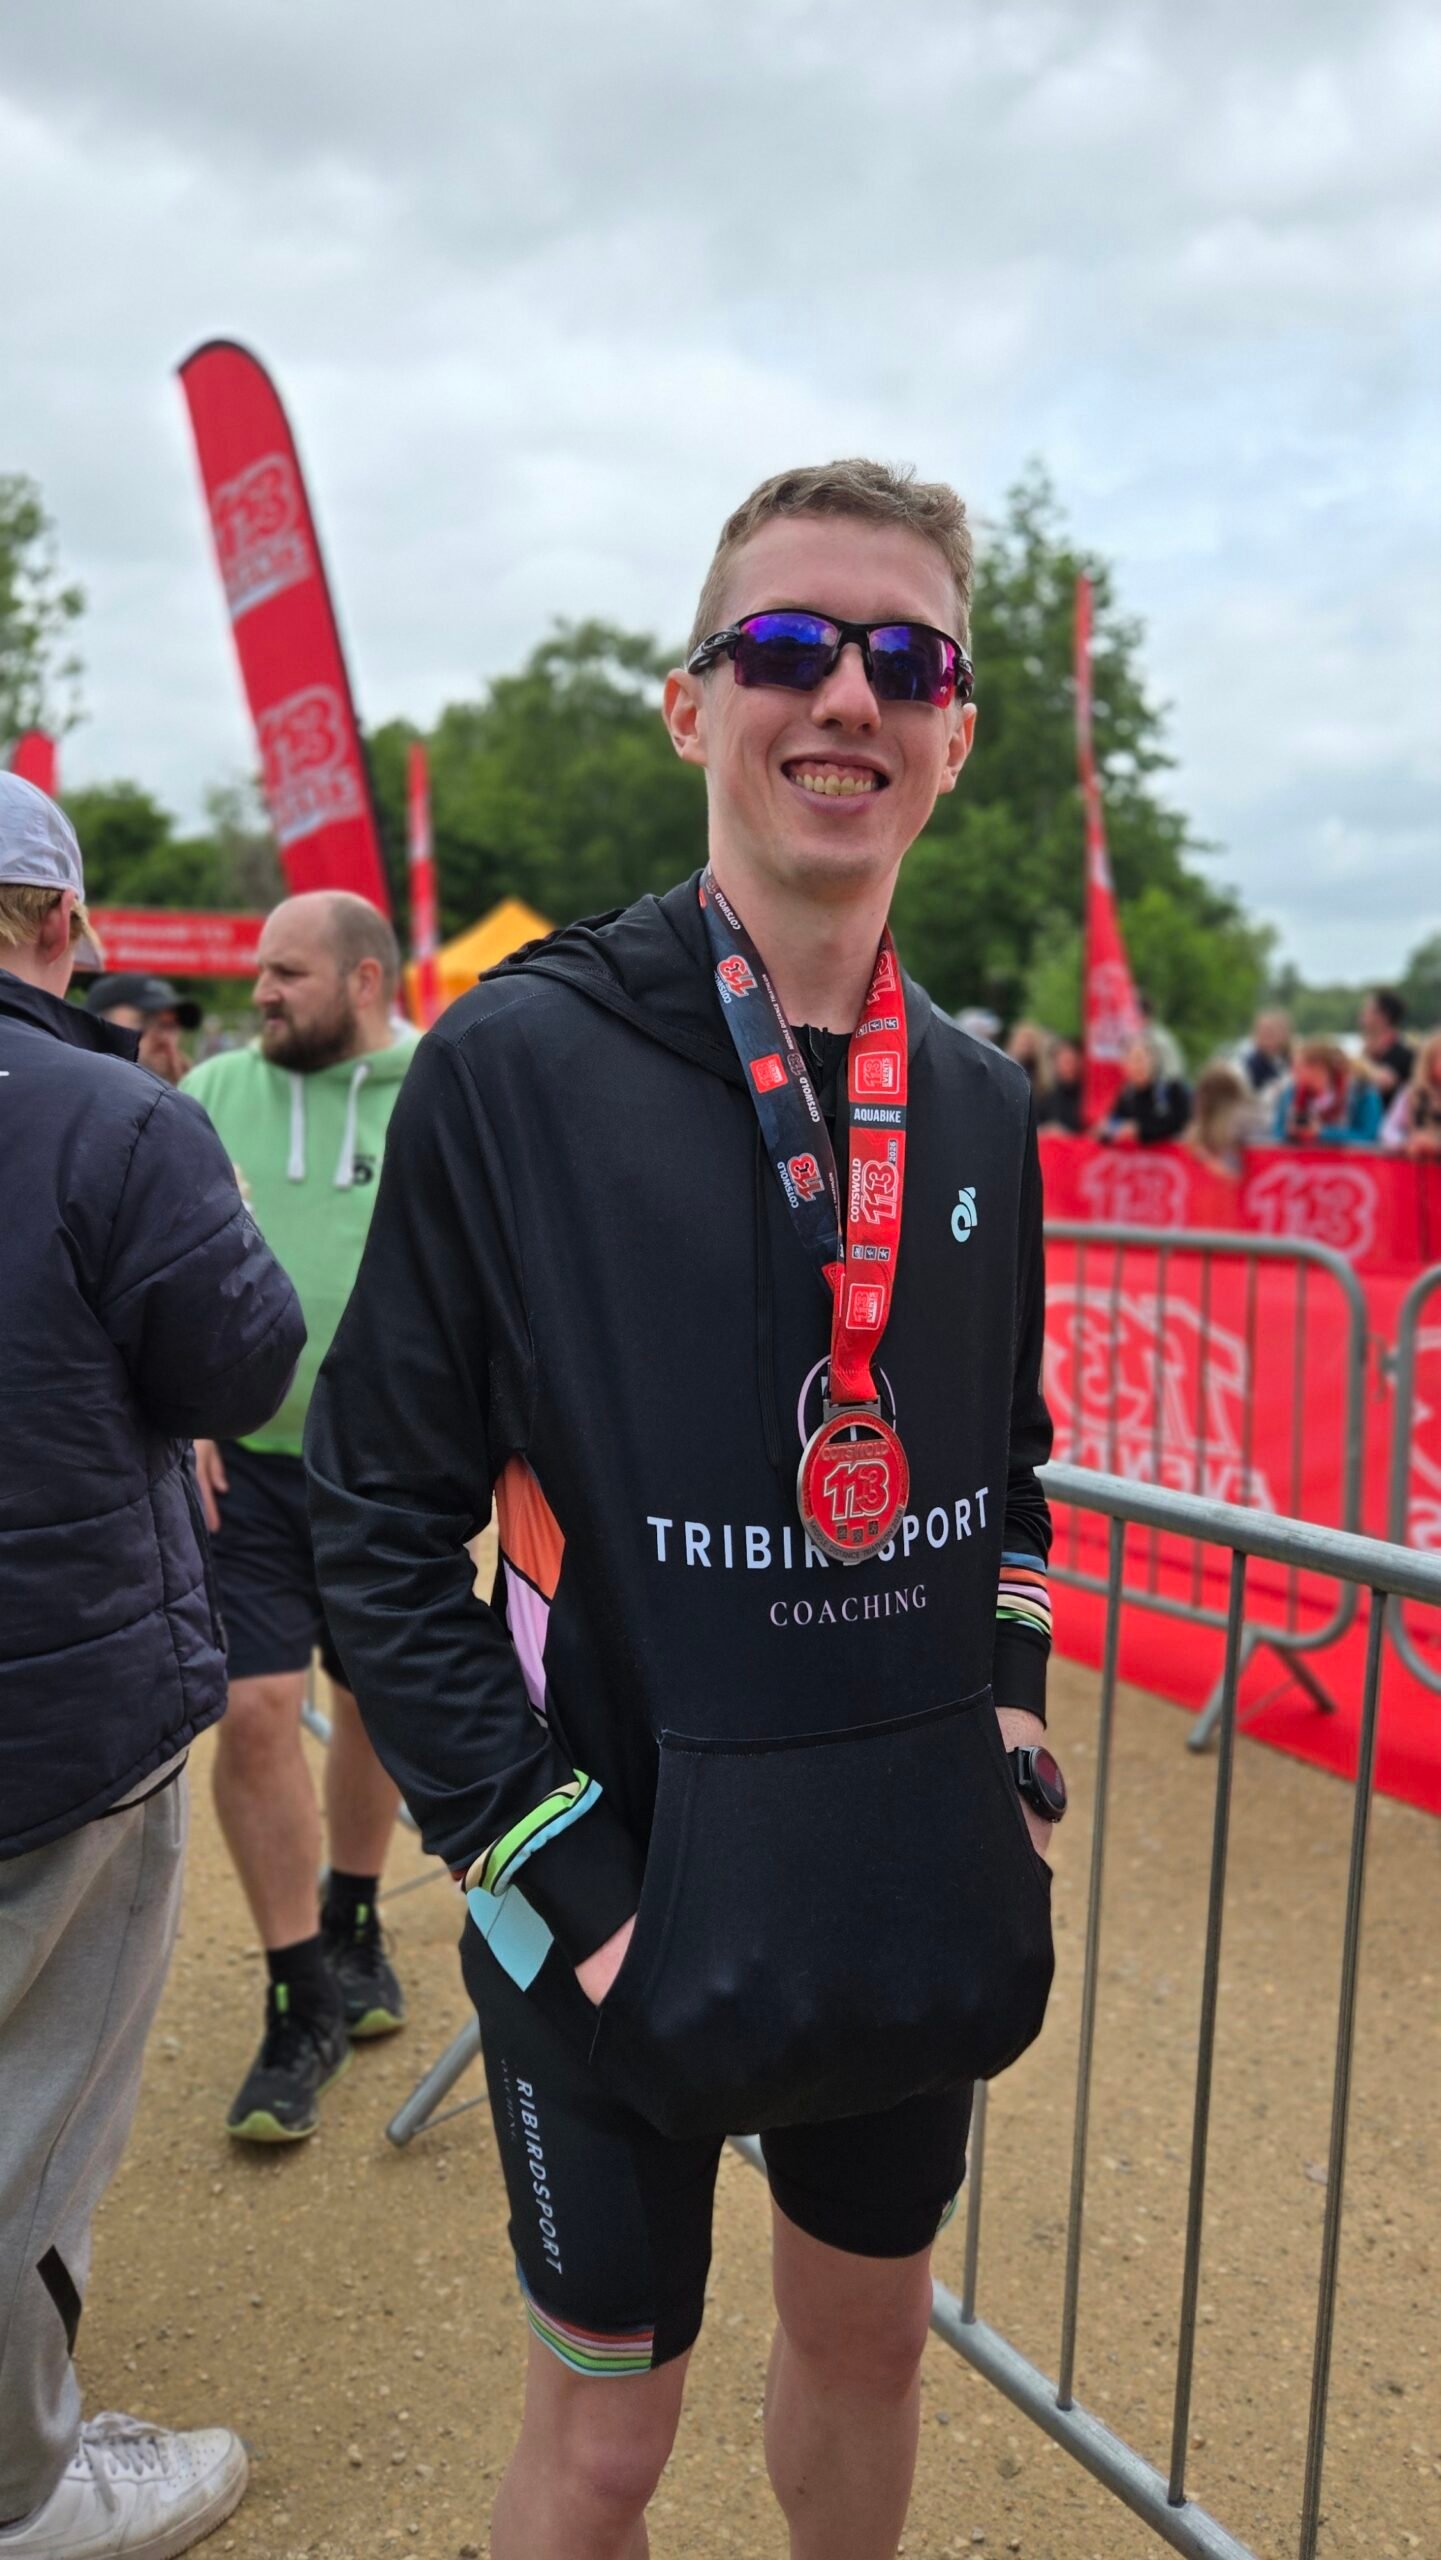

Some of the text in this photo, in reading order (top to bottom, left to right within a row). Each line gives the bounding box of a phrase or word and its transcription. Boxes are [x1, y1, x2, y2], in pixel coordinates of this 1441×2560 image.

[714, 892, 741, 930] COTSWOLD
[714, 970, 732, 1004] COTSWO
[863, 1058, 883, 1088] 113
[799, 1076, 821, 1123] COTSWOLD
[853, 1107, 902, 1123] AQUABIKE
[777, 1161, 800, 1208] COTSWOLD
[850, 1158, 861, 1222] COTSWOLD
[860, 1160, 899, 1225] 113
[1247, 1160, 1378, 1261] 113
[821, 1442, 890, 1461] COTSWOLD
[823, 1458, 890, 1521] 113
[646, 1487, 989, 1569] TRIBIRSPORT
[769, 1584, 927, 1626] COACHING
